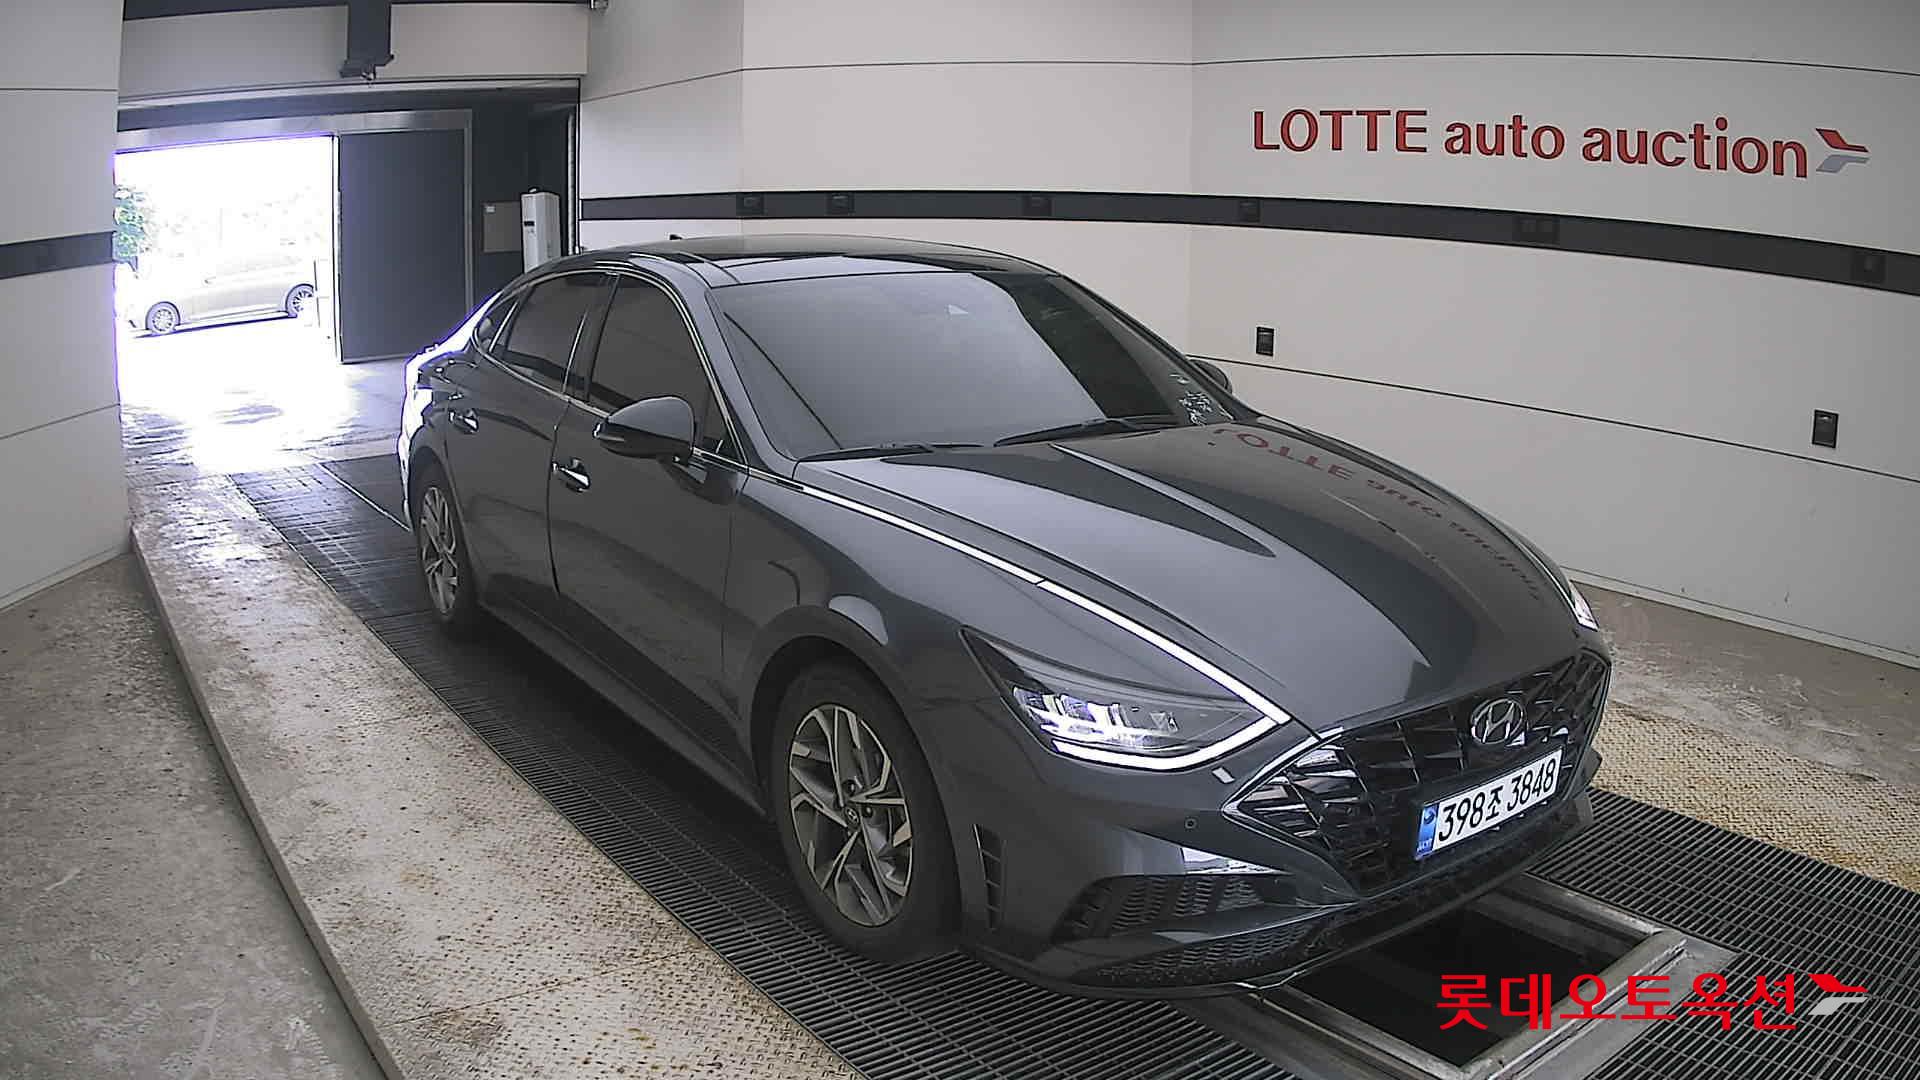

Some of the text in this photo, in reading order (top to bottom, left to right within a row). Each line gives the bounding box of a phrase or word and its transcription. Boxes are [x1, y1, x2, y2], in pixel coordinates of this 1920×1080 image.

[1253, 109, 1809, 179] LOTTE auto auction
[1438, 758, 1556, 842] 398조 3848
